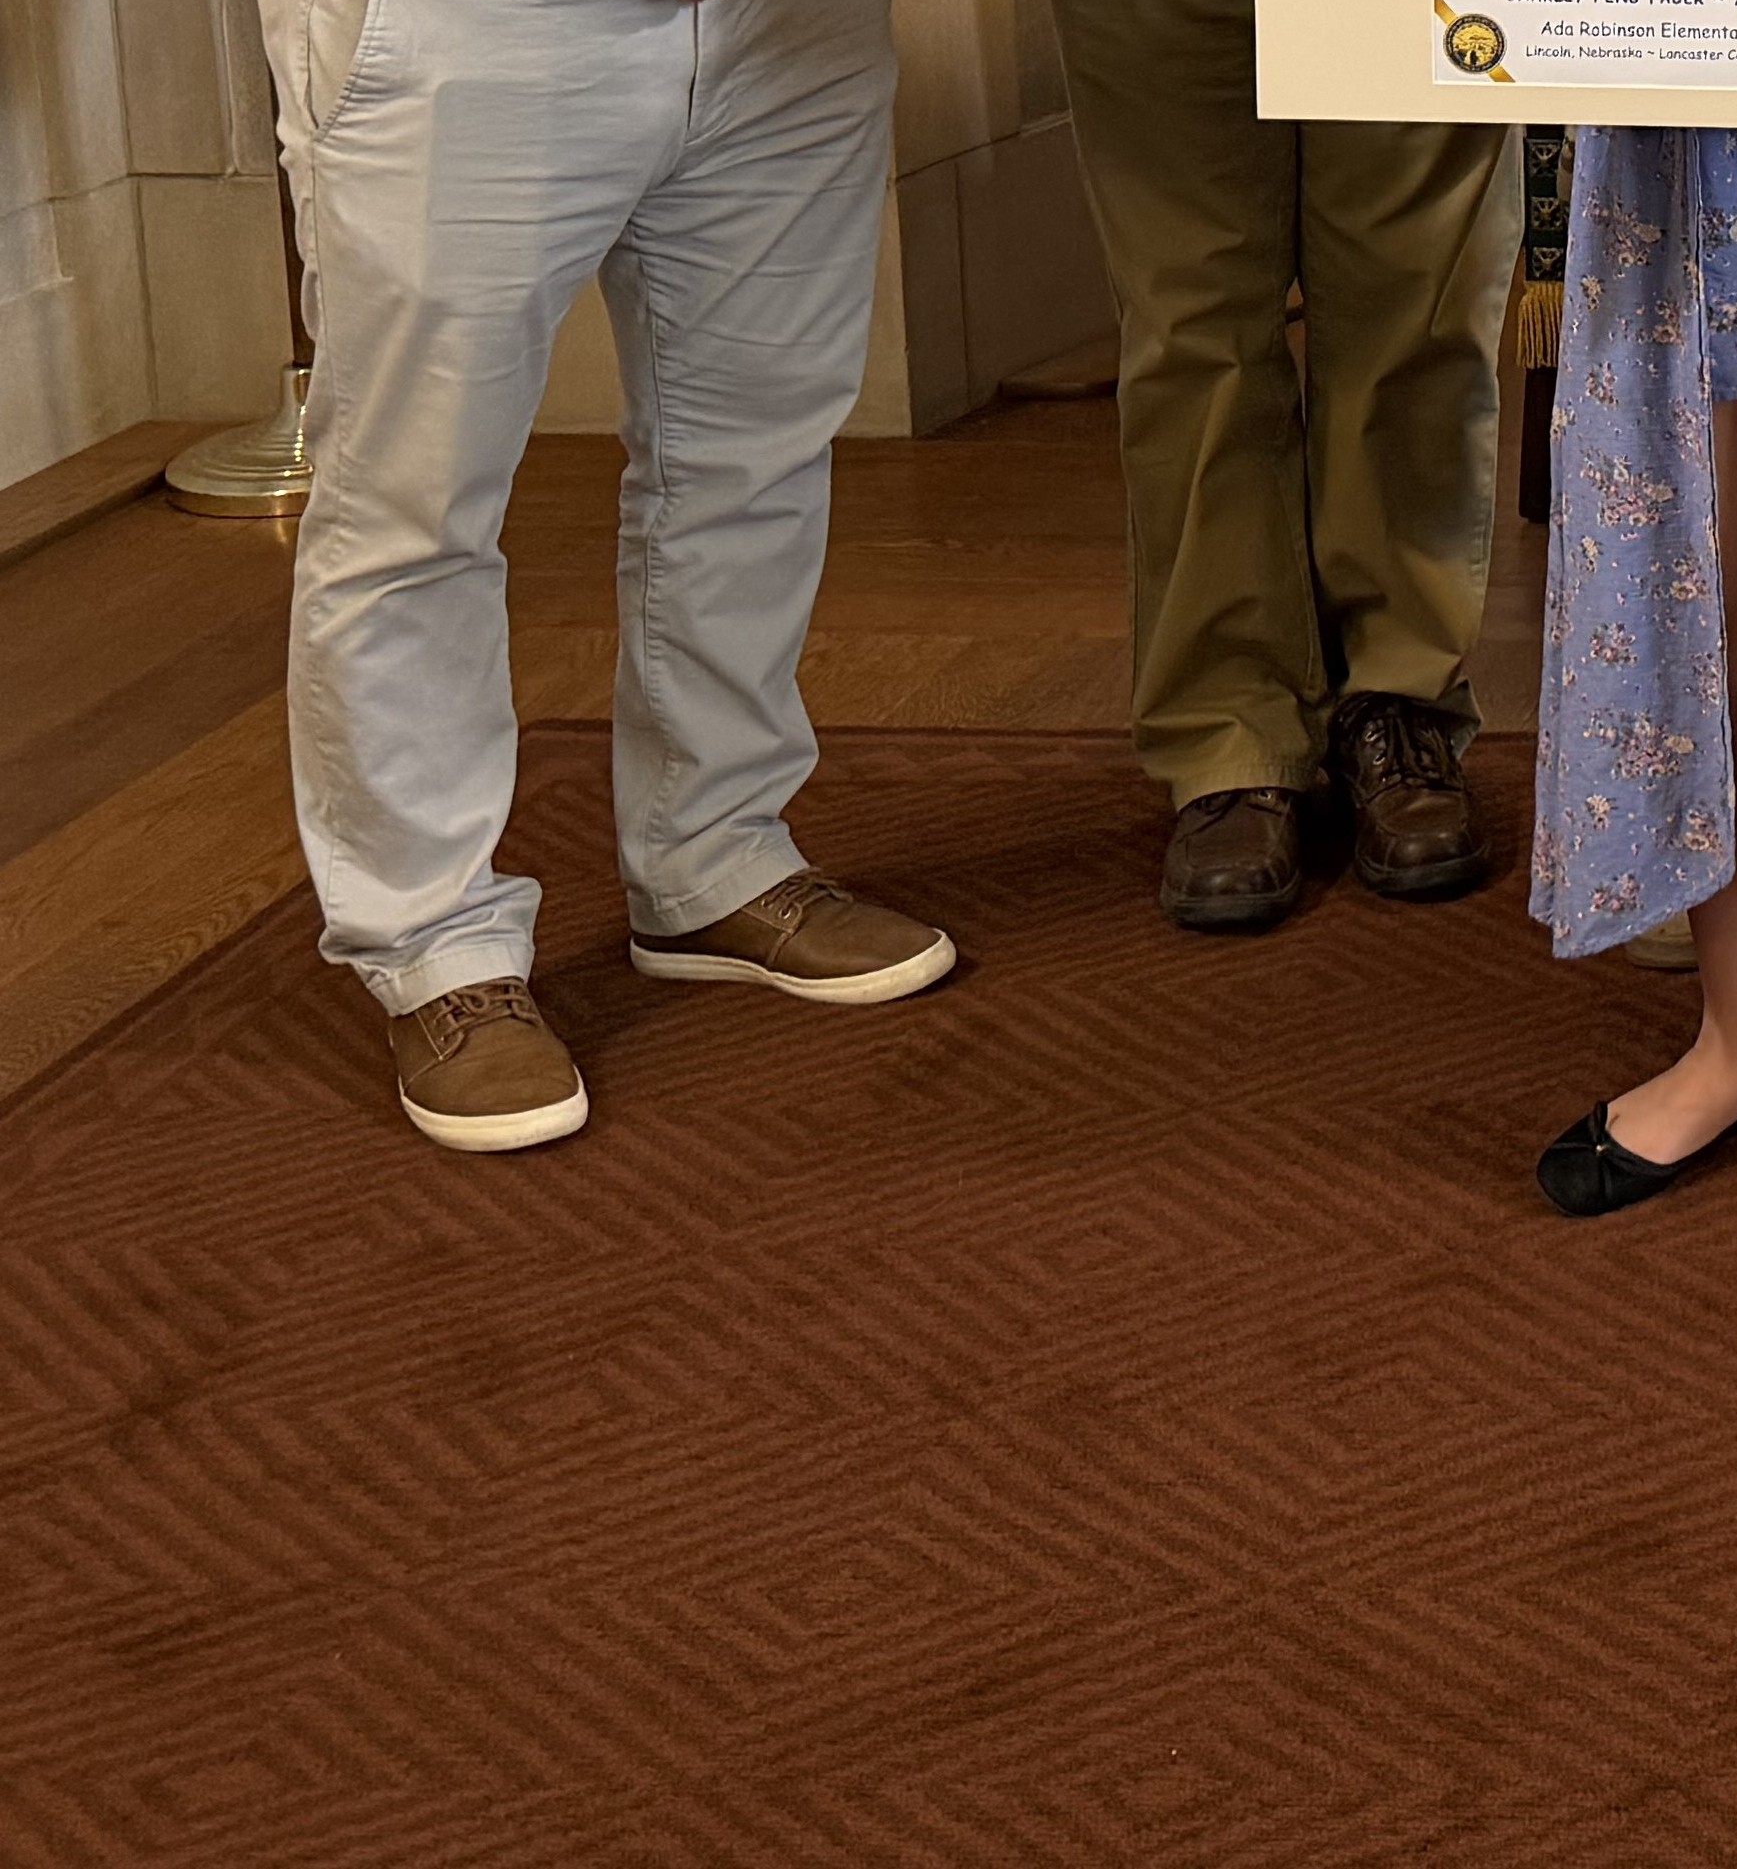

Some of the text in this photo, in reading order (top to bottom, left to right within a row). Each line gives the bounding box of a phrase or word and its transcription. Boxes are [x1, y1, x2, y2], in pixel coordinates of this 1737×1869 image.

[1541, 21, 1575, 38] Ada
[1579, 21, 1655, 39] Robinson
[1525, 45, 1576, 60] Lincoln,
[1578, 45, 1643, 60] Nebraska
[1659, 48, 1724, 62] Lancaster
